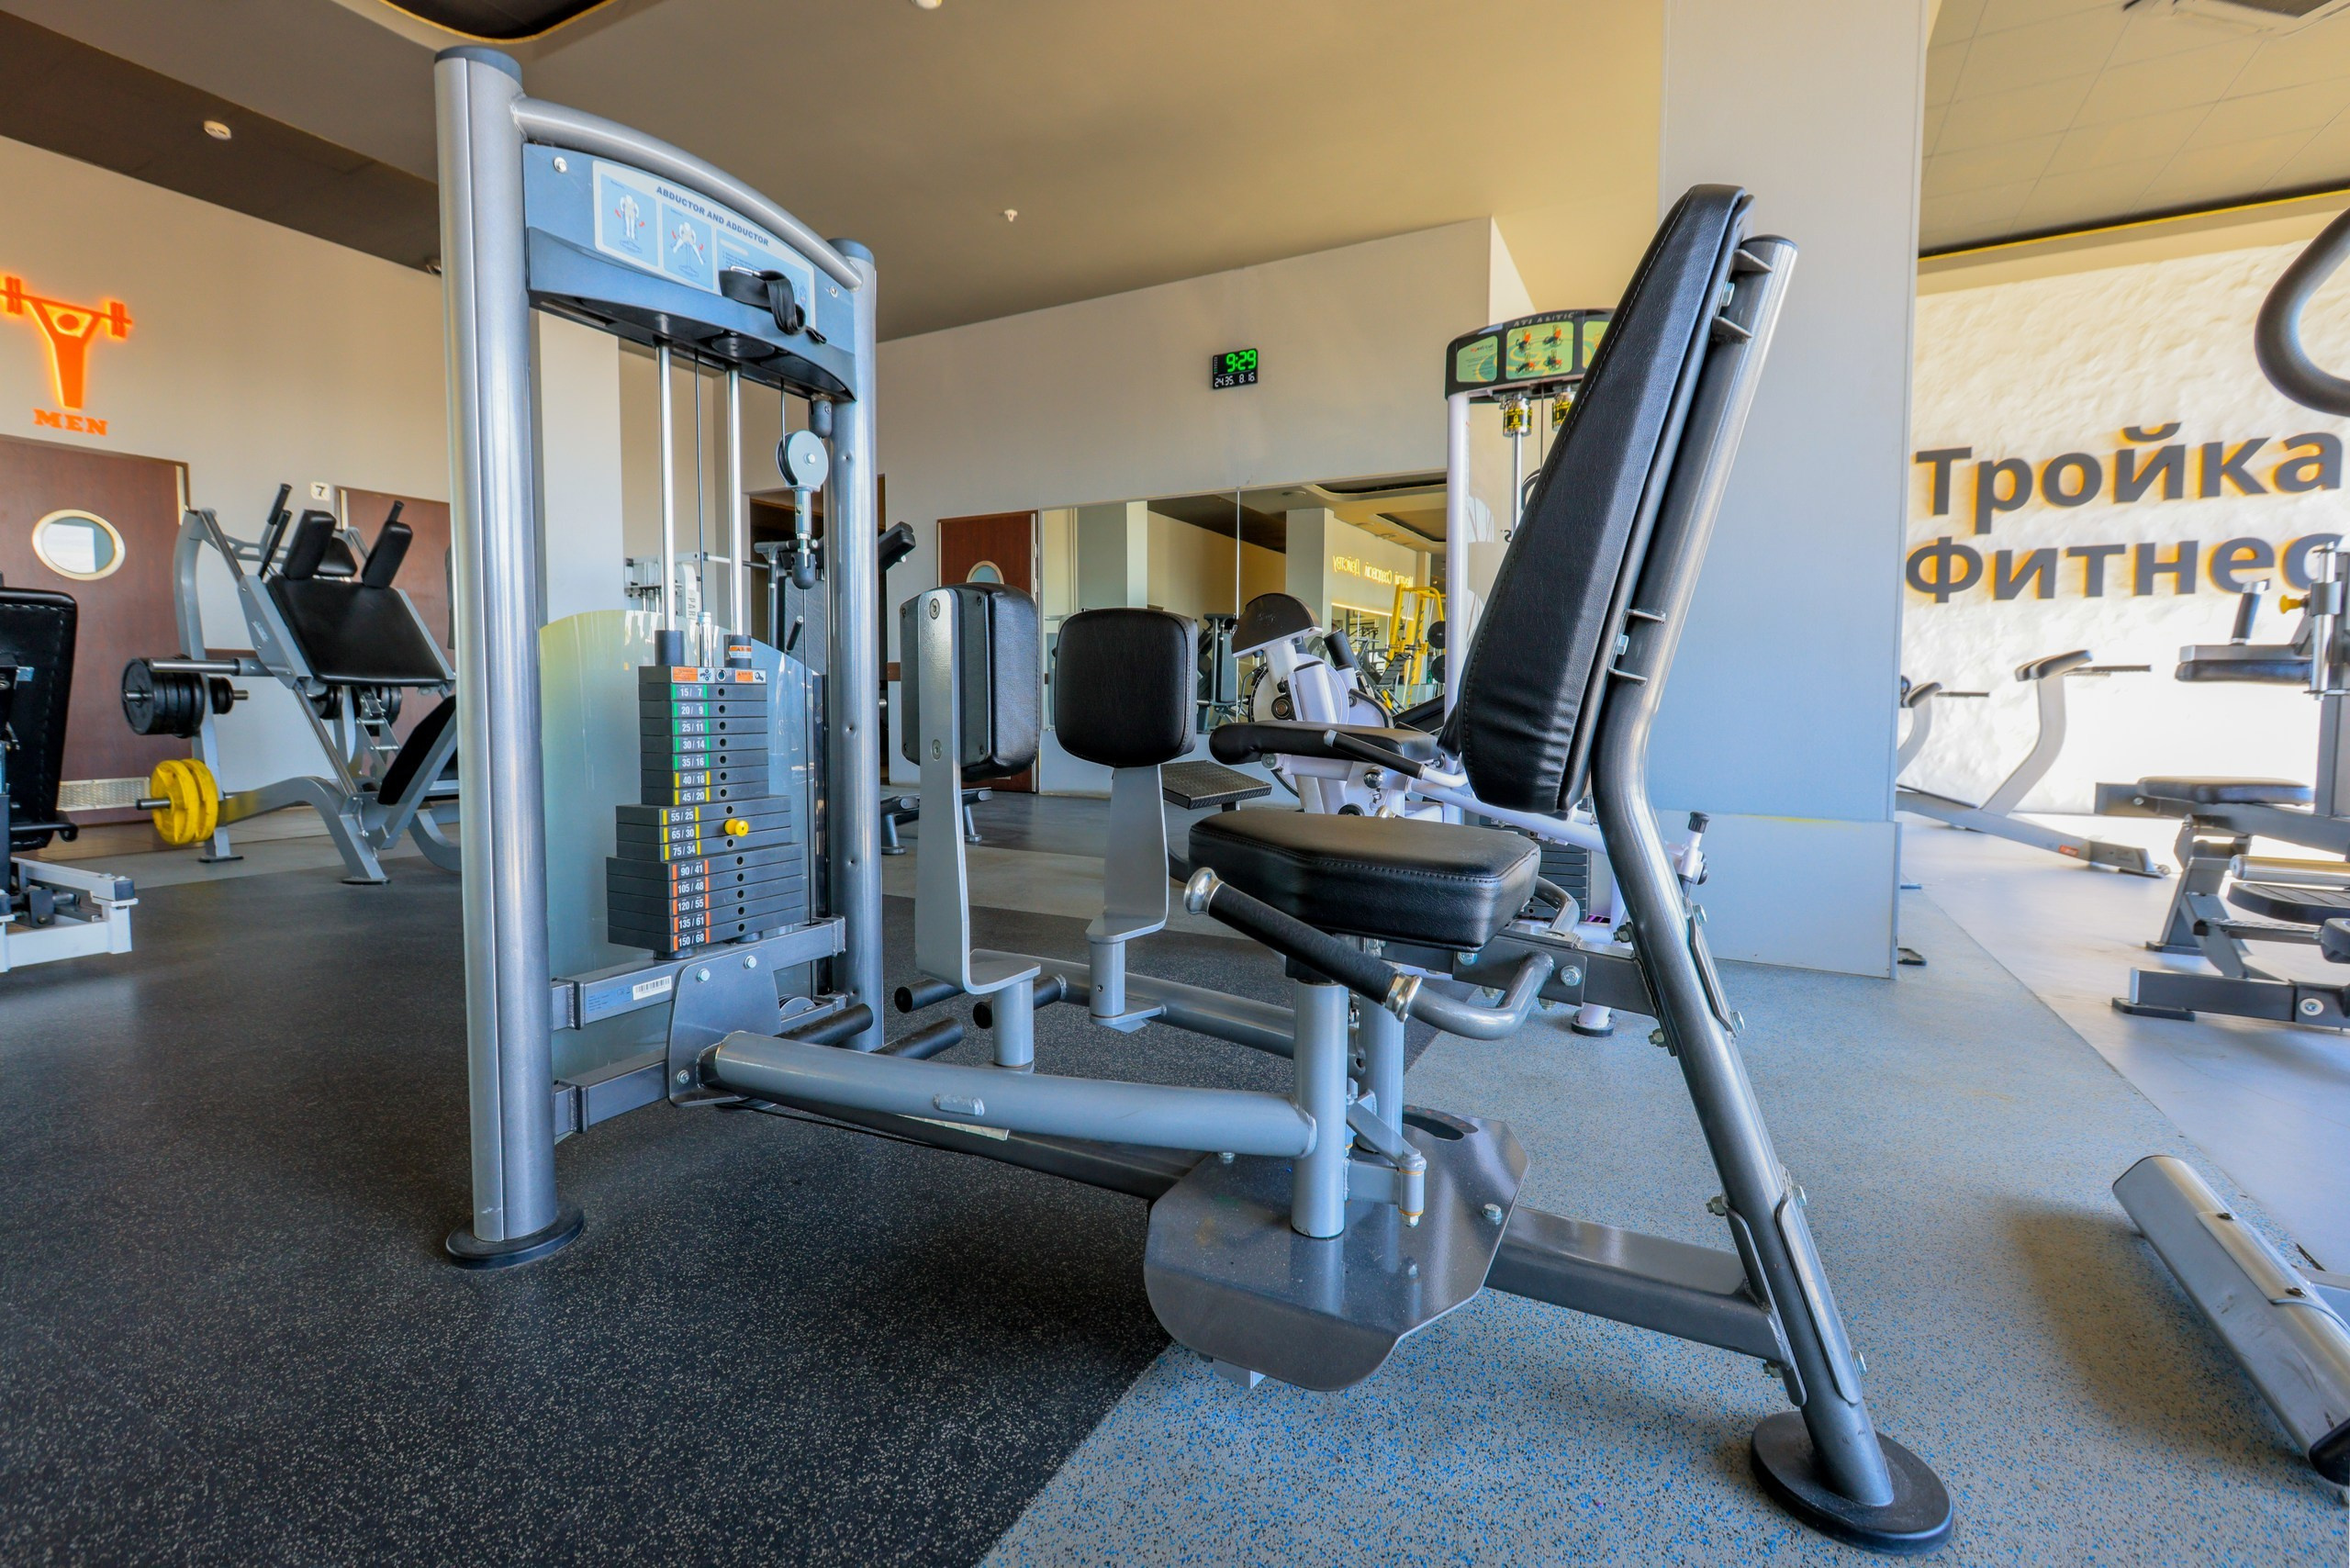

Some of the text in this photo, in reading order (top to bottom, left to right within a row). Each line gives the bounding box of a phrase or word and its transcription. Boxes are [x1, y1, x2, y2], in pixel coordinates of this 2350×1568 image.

[656, 186, 769, 246] ABDUCTOR AND ADDUCTOR
[1226, 350, 1257, 373] 9:29
[32, 408, 108, 436] MEN
[315, 485, 325, 497] 7
[1916, 422, 2343, 534] Тройка
[1905, 532, 2344, 603] Фитнес
